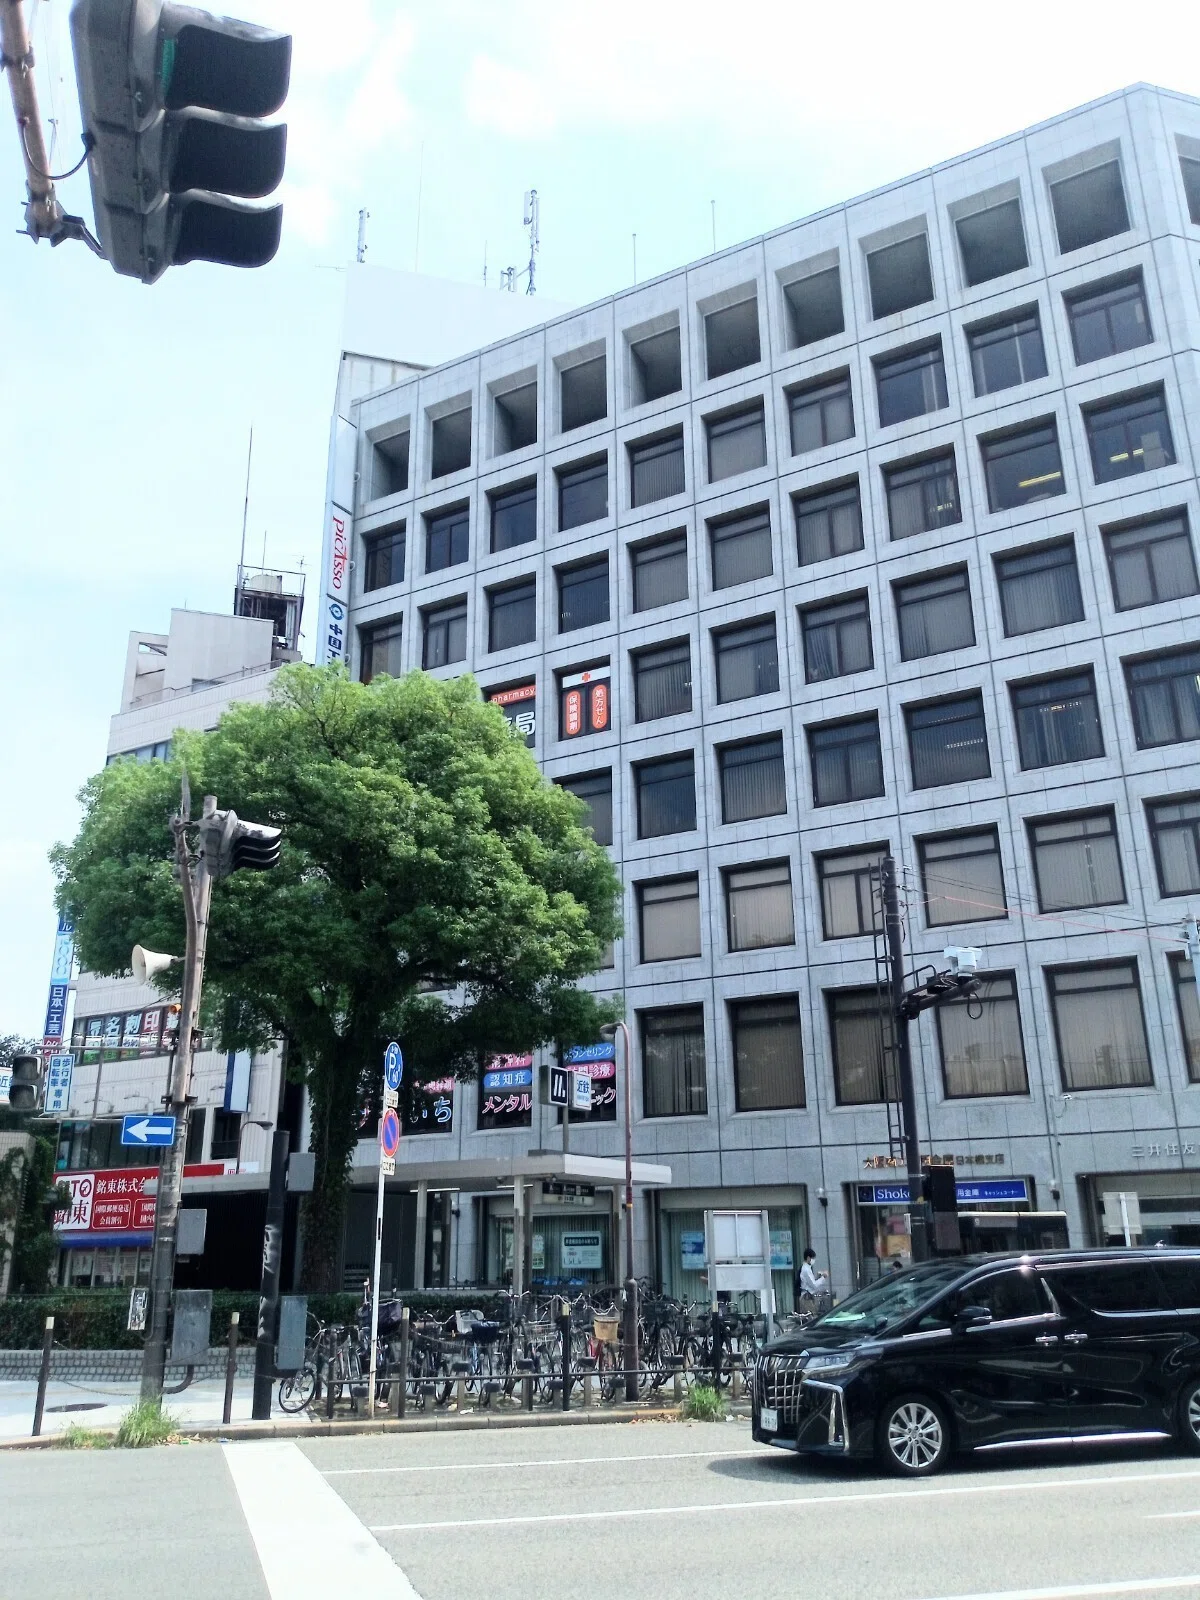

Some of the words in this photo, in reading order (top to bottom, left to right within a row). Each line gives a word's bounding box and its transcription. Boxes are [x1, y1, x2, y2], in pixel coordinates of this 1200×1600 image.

[594, 688, 605, 724] 処方せん
[506, 711, 536, 737] 局
[51, 1058, 61, 1088] 自転車
[61, 1057, 71, 1087] 歩行者
[490, 1072, 525, 1087] 認知症
[53, 1089, 63, 1109] 専用
[481, 1093, 532, 1115] メンタル
[1131, 1140, 1200, 1157] 三井住友
